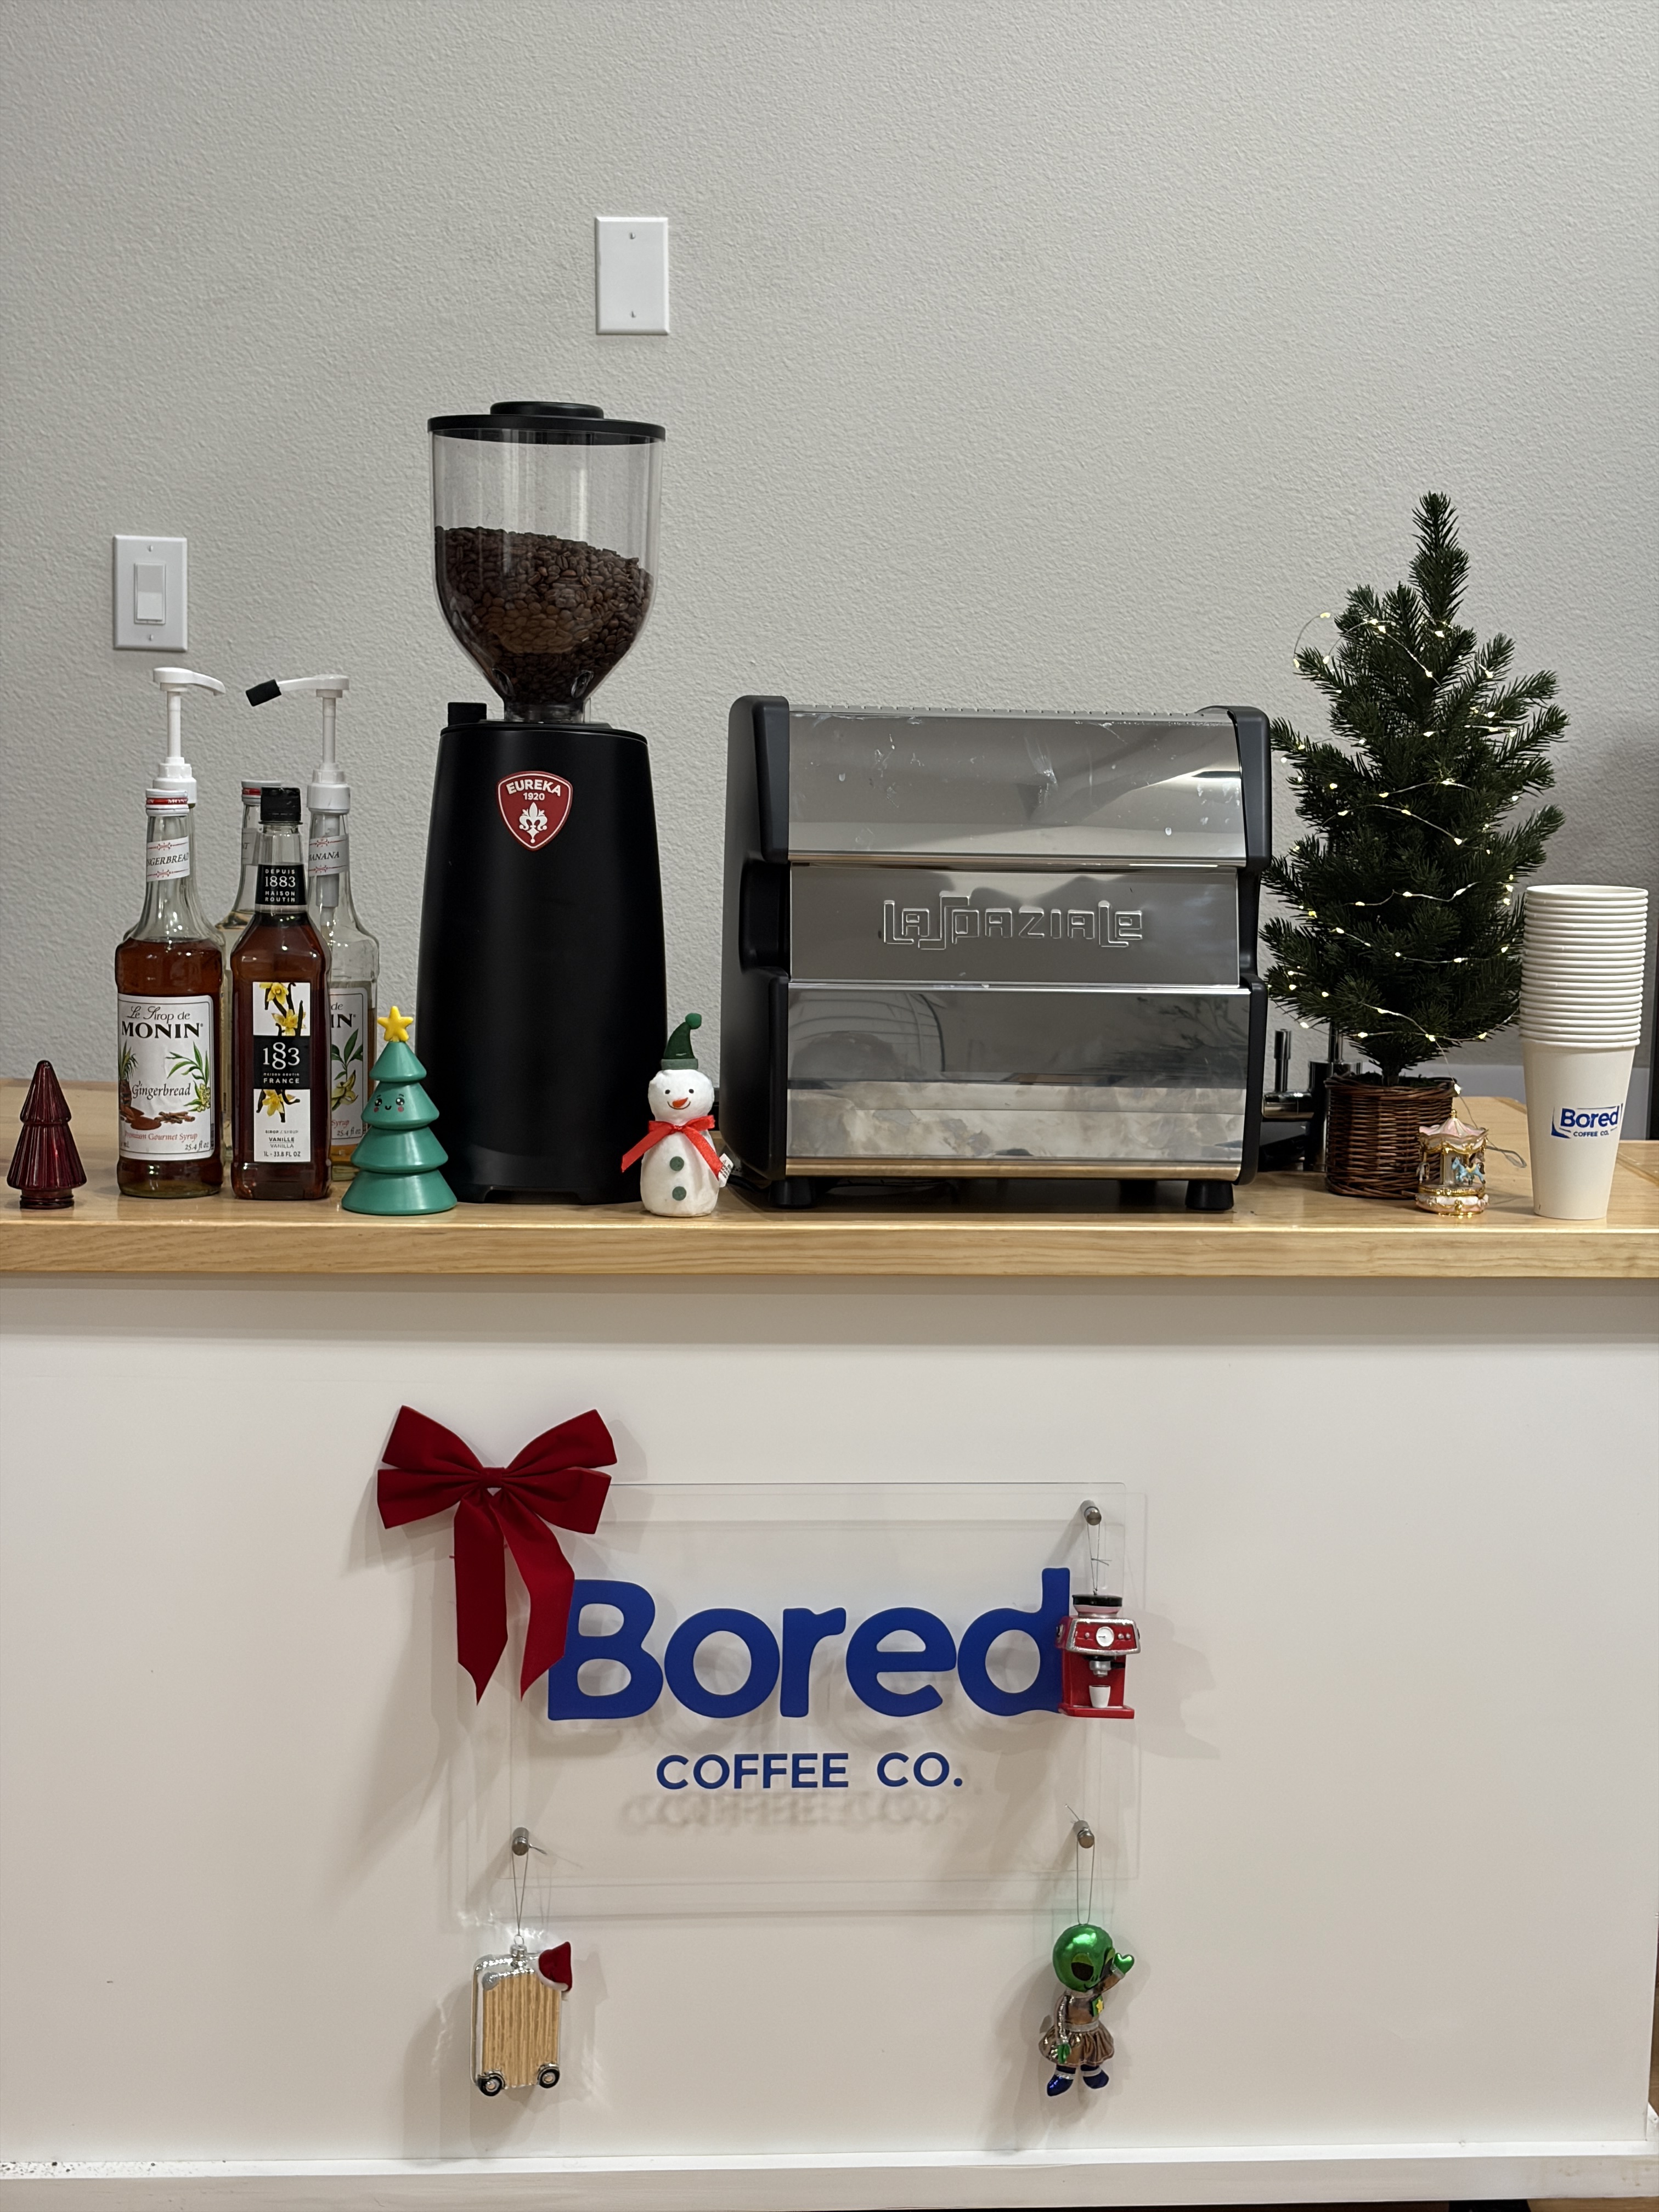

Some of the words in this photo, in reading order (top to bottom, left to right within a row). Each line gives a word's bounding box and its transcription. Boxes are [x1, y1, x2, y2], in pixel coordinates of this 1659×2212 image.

[506, 779, 561, 797] EUREKA
[523, 792, 545, 800] 1920
[265, 876, 296, 887] 1883
[127, 1006, 140, 1019] Le
[143, 1006, 174, 1024] Sirop
[177, 1012, 190, 1020] de
[122, 1021, 199, 1039] MONIN
[132, 1080, 191, 1100] Gingerbread
[1560, 1105, 1620, 1128] Bored
[179, 1133, 198, 1143] Syrup
[548, 1567, 1070, 1720] Bored
[656, 1753, 849, 1790] COFFEE
[877, 1752, 963, 1787] CO.
